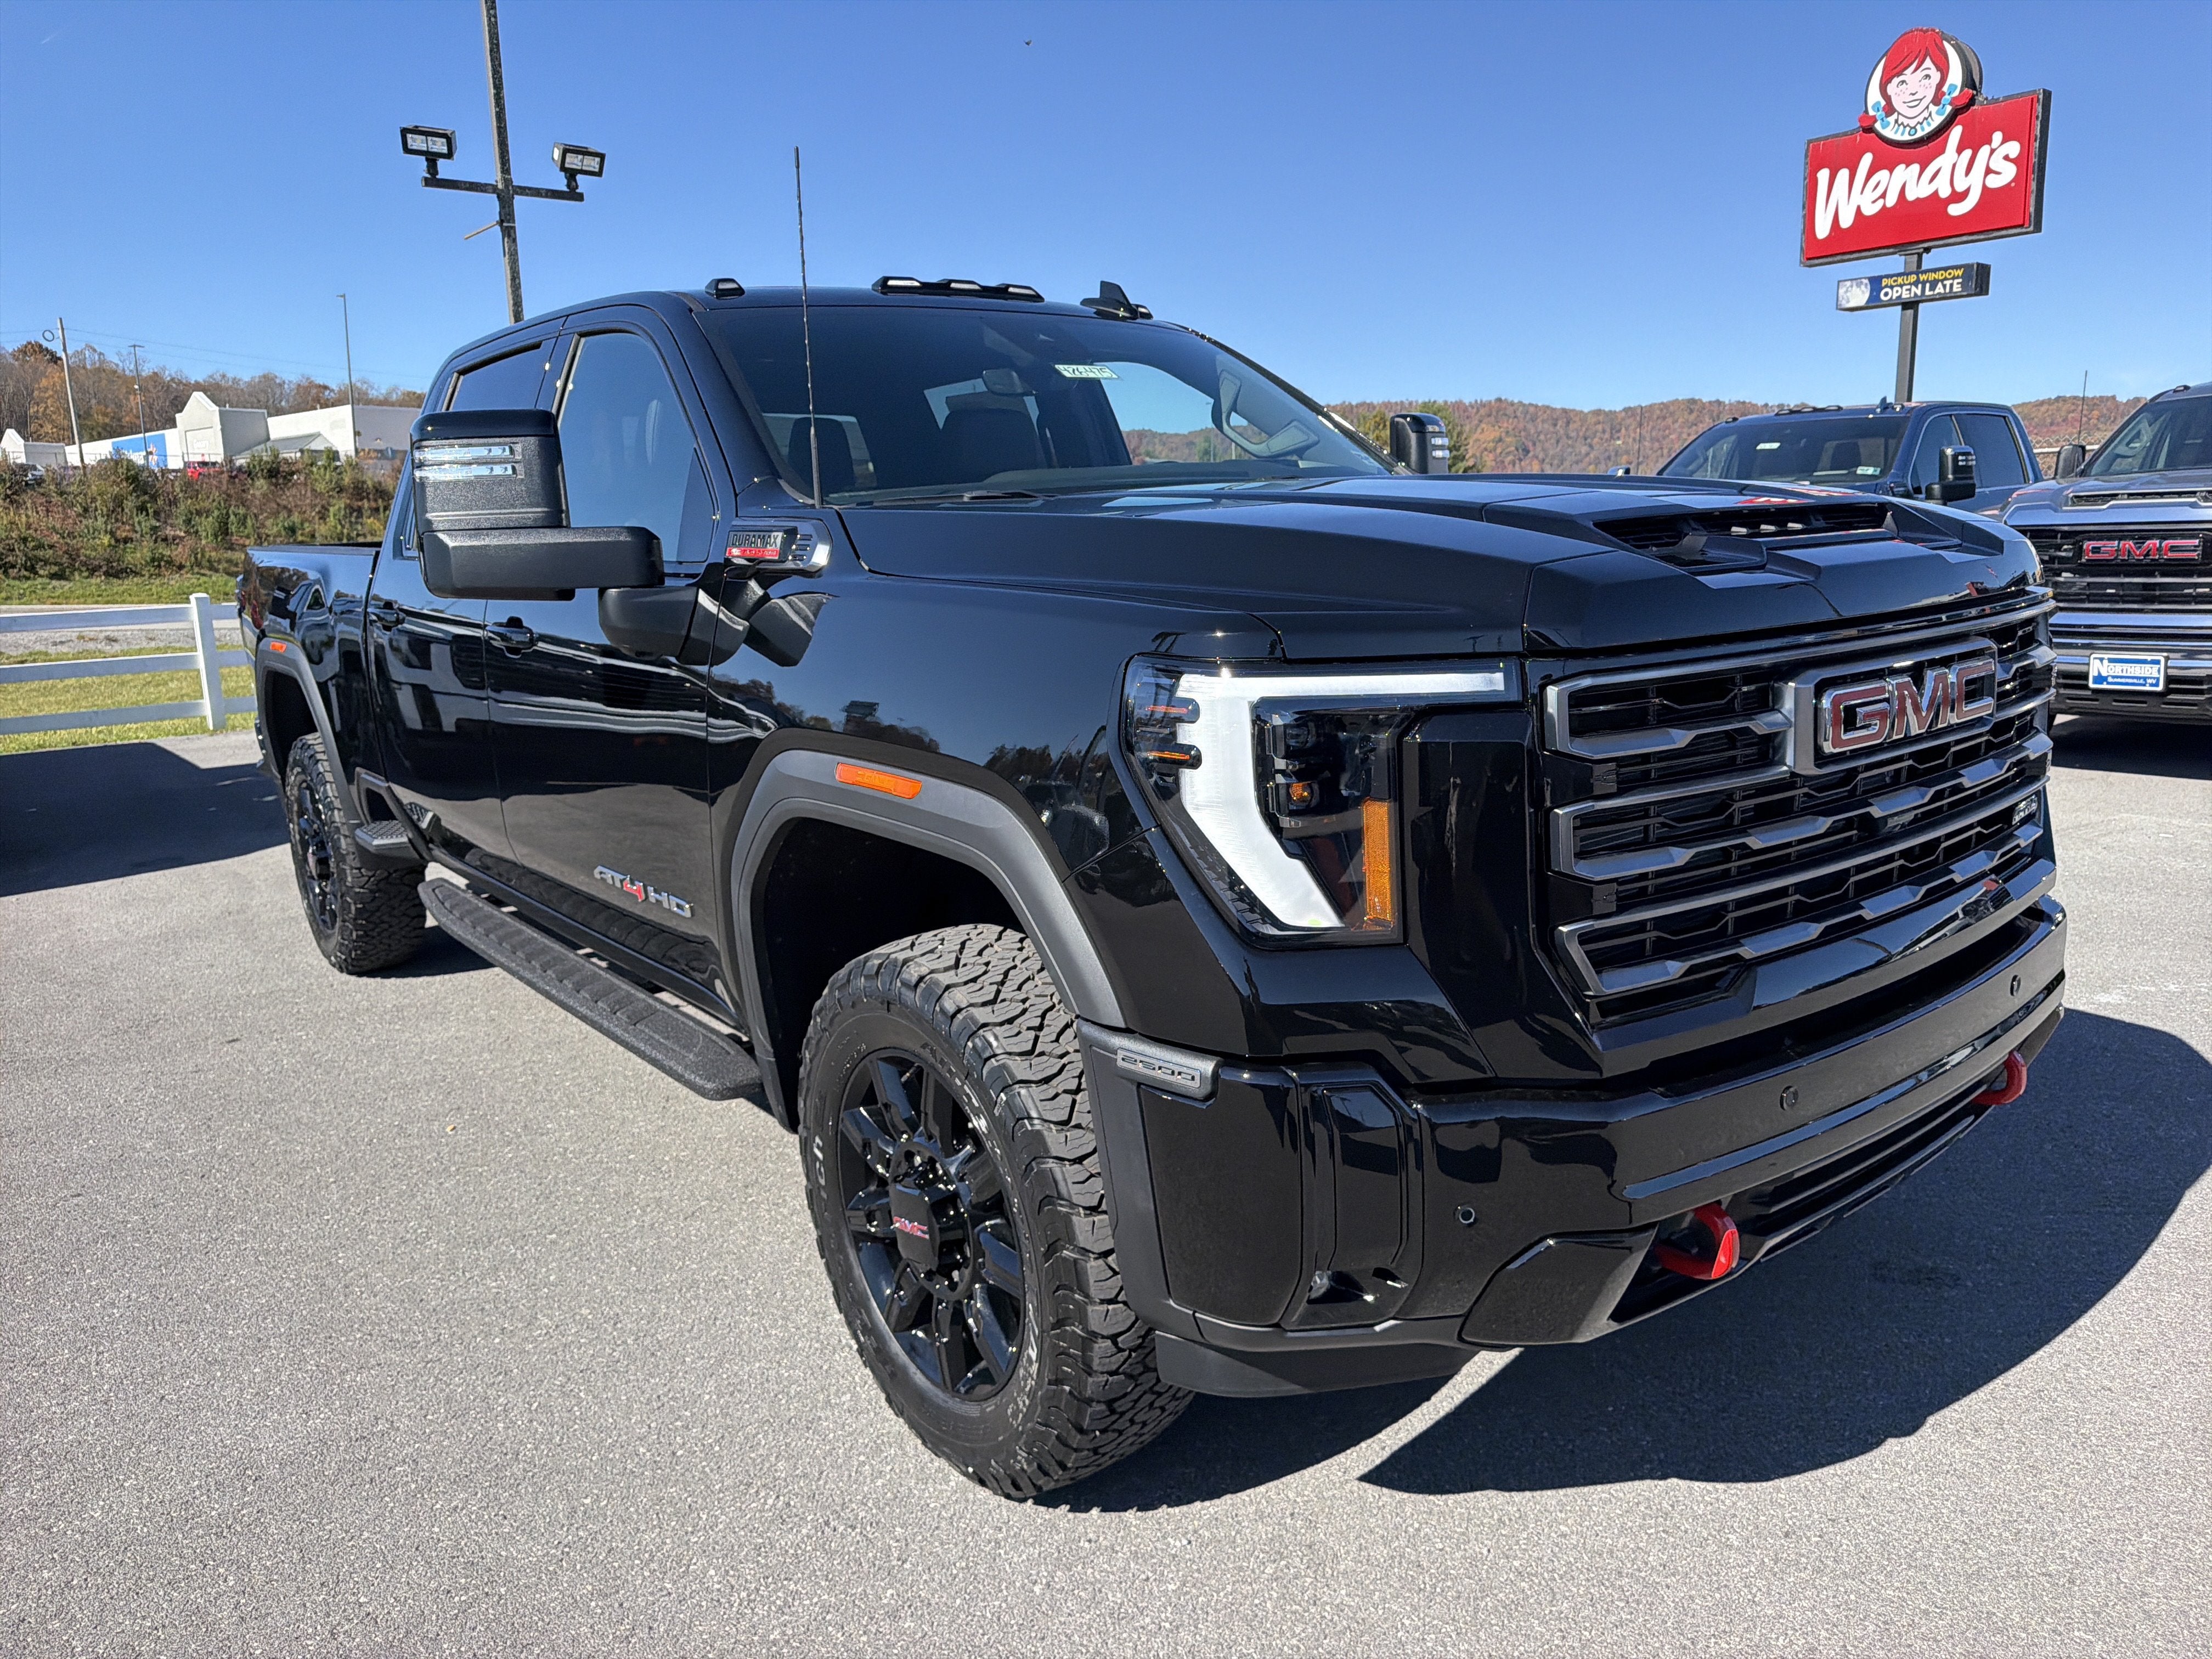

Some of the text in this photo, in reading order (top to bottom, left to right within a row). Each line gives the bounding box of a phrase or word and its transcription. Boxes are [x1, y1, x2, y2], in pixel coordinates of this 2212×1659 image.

[1815, 125, 2021, 239] Wendy's
[1881, 267, 1965, 287] PICKUP WINDOW
[1880, 278, 1963, 301] OPEN LATE
[731, 534, 779, 548] DURAMAX
[2085, 540, 2199, 560] GMC
[2093, 659, 2159, 676] NORTHSIDE
[1823, 658, 1995, 753] GMC
[1121, 1054, 1195, 1082] 2500
[892, 1216, 930, 1239] GMC
